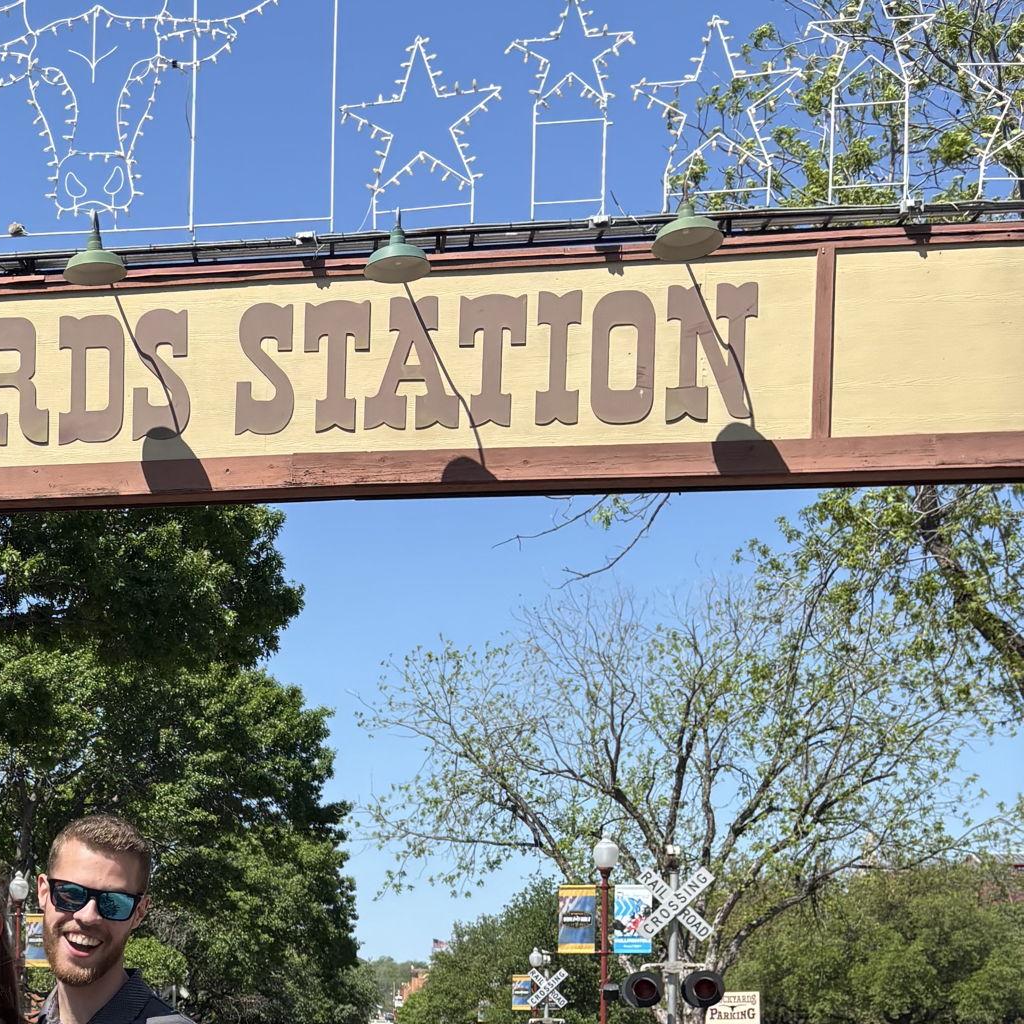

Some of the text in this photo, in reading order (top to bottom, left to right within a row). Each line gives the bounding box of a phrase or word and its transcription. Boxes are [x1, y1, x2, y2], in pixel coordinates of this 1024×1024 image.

[234, 281, 759, 436] STATION
[640, 871, 709, 938] RAIL ROAD
[643, 872, 708, 935] CROSSING
[529, 970, 566, 1006] RAIL ROAD
[530, 970, 566, 1005] CROSSING
[720, 994, 756, 1005] CKYARDS
[709, 1008, 755, 1020] PARKING
